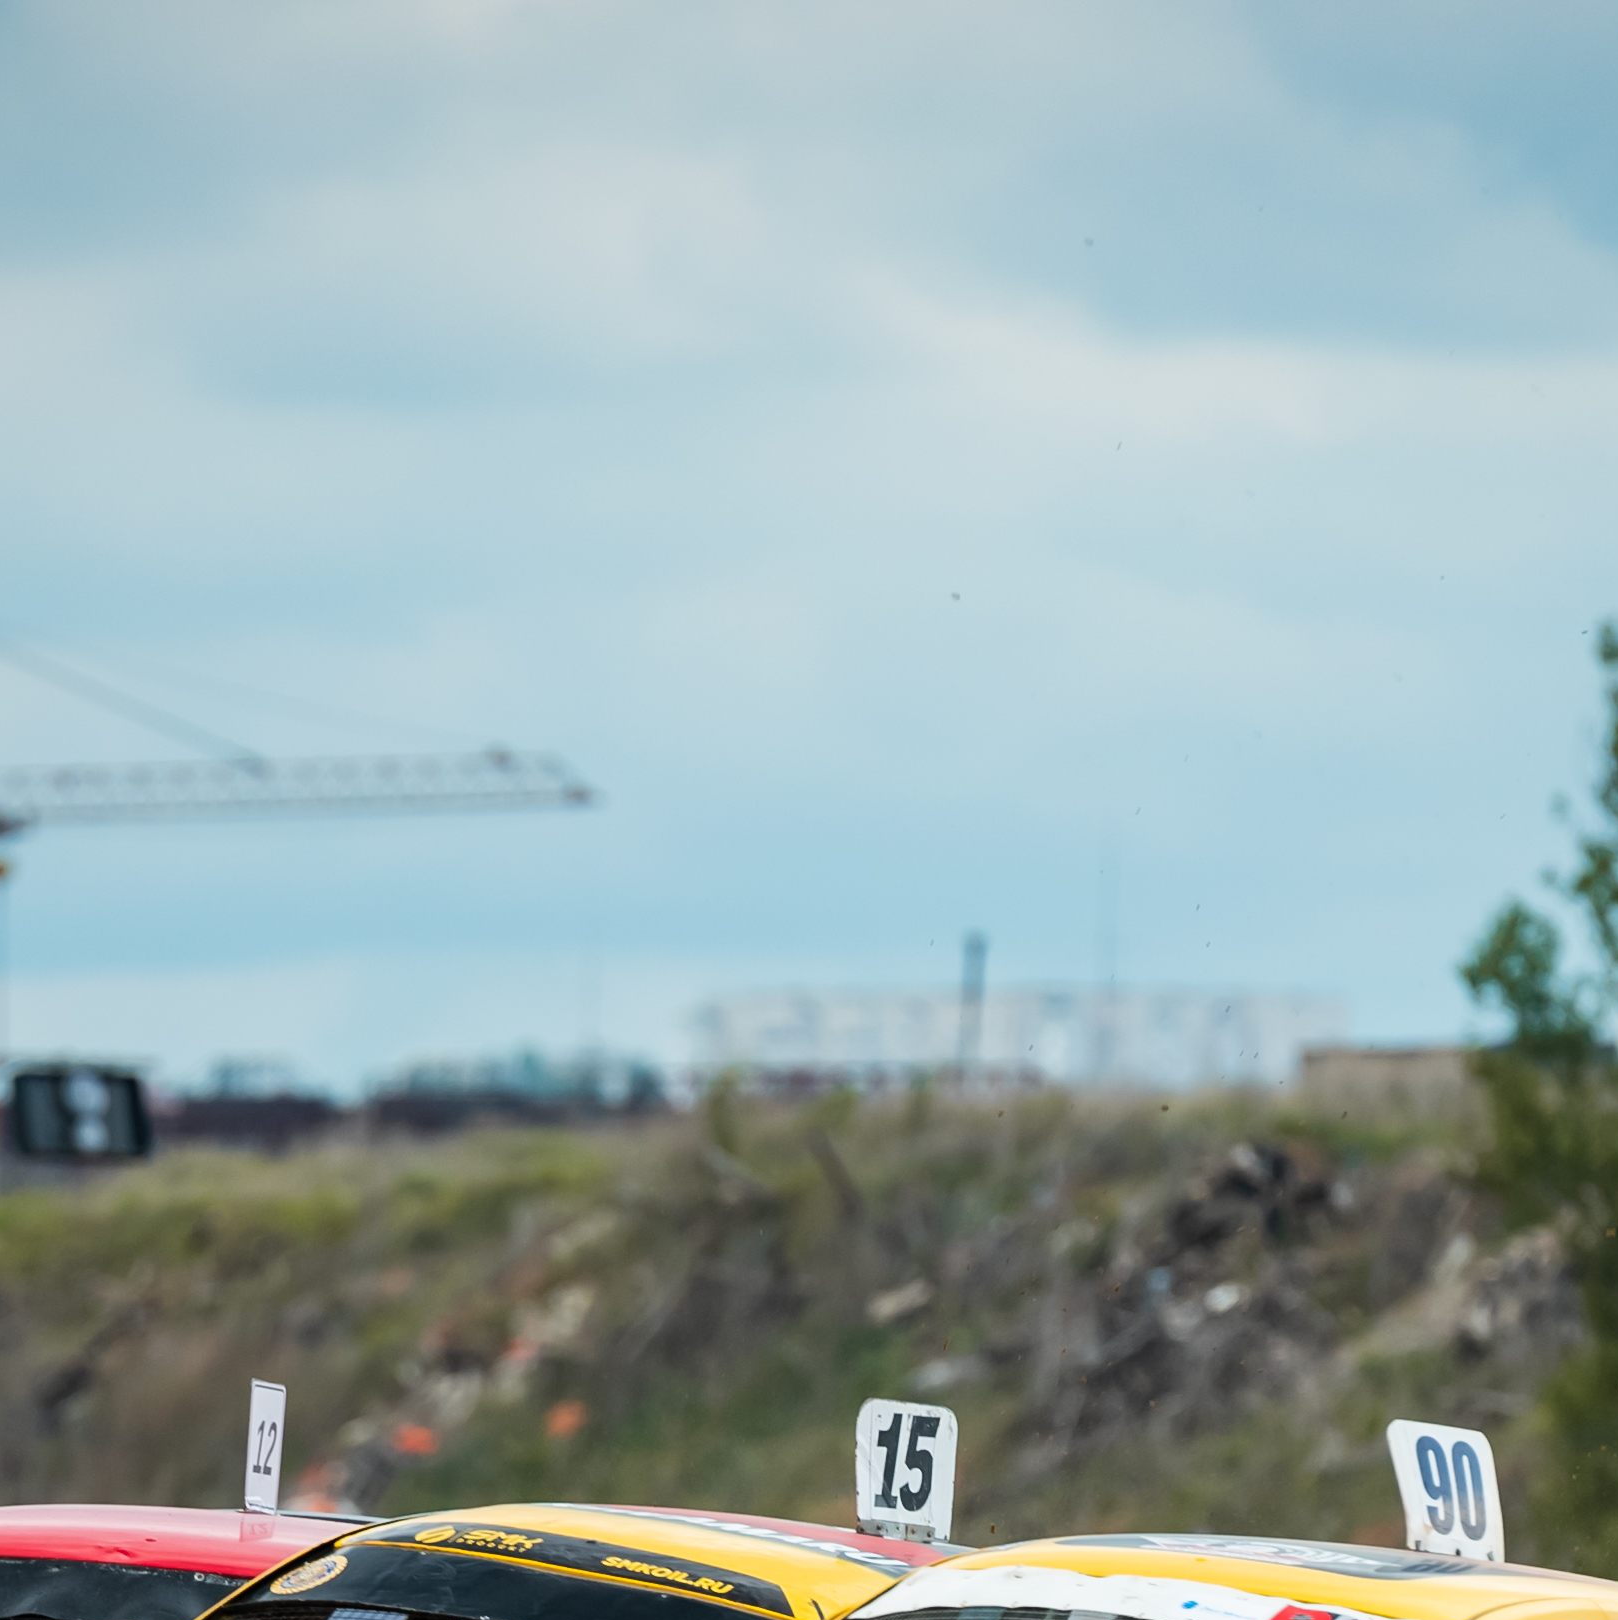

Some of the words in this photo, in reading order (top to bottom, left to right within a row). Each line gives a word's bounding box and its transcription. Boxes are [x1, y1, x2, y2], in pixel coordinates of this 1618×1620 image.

[252, 1420, 278, 1476] 12
[874, 1412, 941, 1512] 15
[1416, 1436, 1487, 1541] 90
[601, 1556, 734, 1594] SMKOIL.RU
